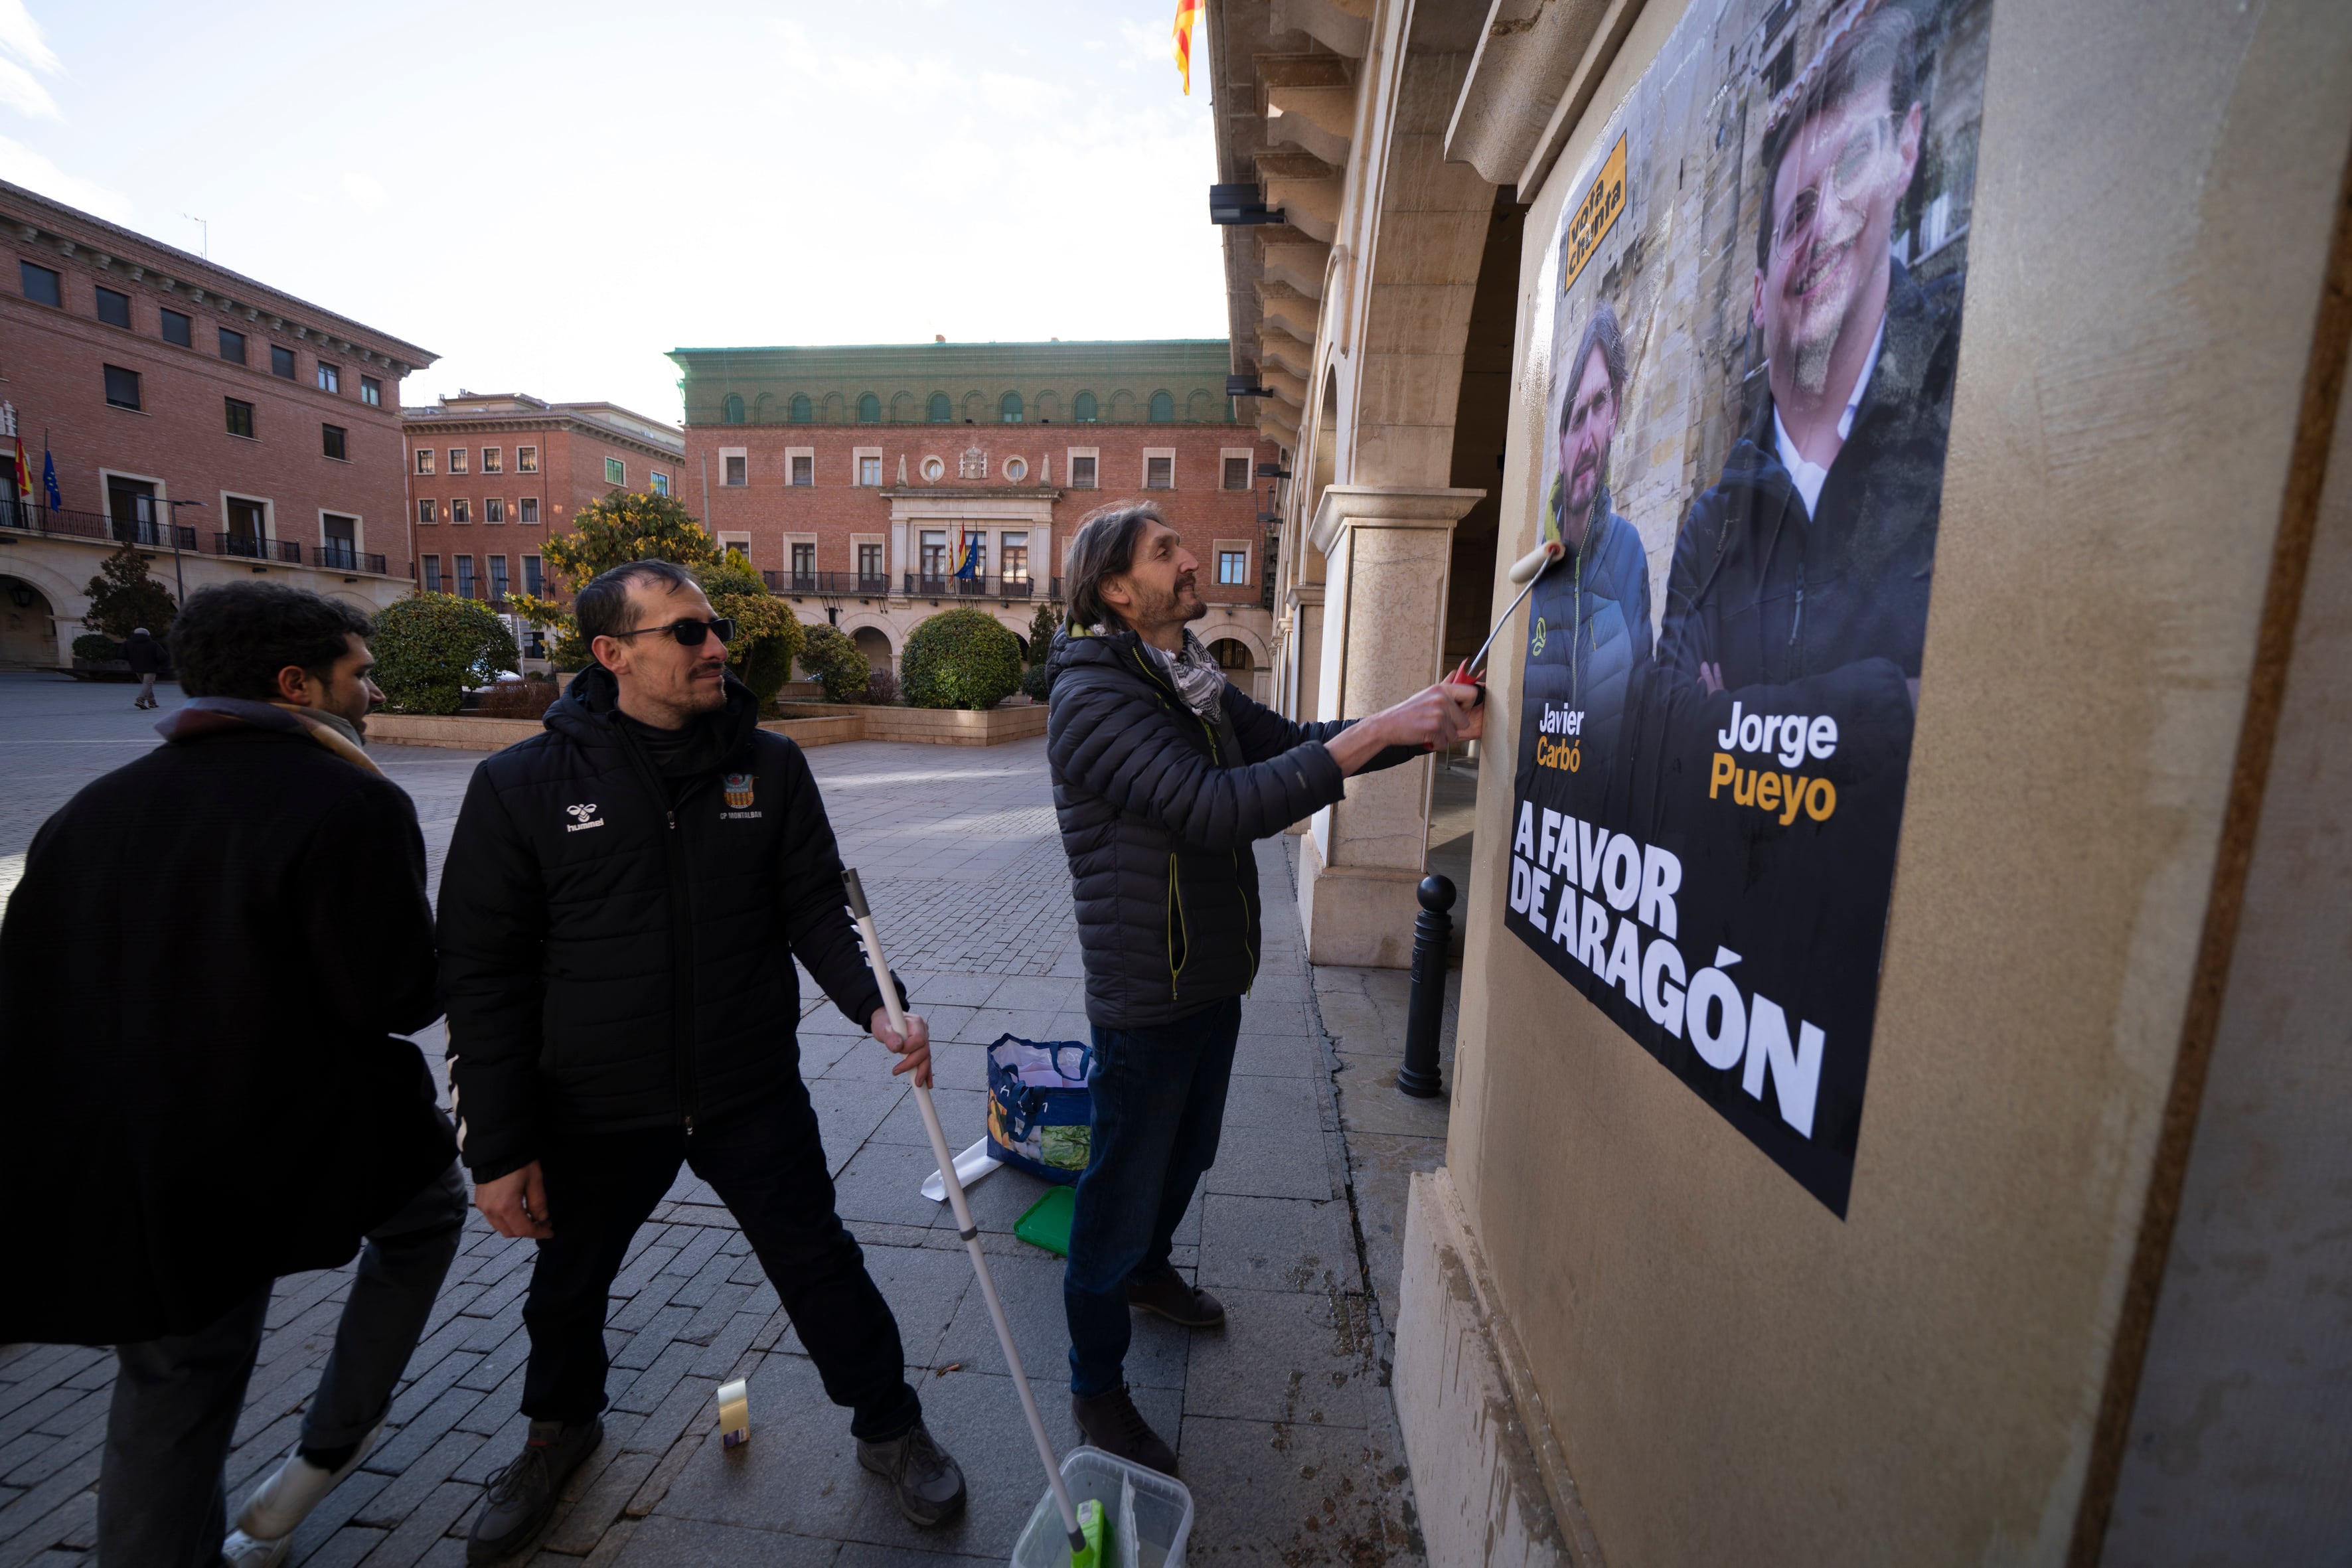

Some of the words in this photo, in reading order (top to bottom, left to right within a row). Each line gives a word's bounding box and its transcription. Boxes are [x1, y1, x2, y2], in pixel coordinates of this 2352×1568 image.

[1569, 180, 1622, 275] chunta
[1571, 179, 1604, 243] vota
[1539, 703, 1585, 735] Javier
[1718, 702, 1838, 768] Jorge
[1537, 736, 1581, 773] Carbó
[1709, 753, 1837, 825] Pueyo
[567, 817, 605, 832] hummel
[1514, 800, 1535, 860] A
[1539, 807, 1683, 940] FAVOR
[1510, 855, 1551, 933] DE
[1551, 884, 1826, 1140] ARAGÓN
